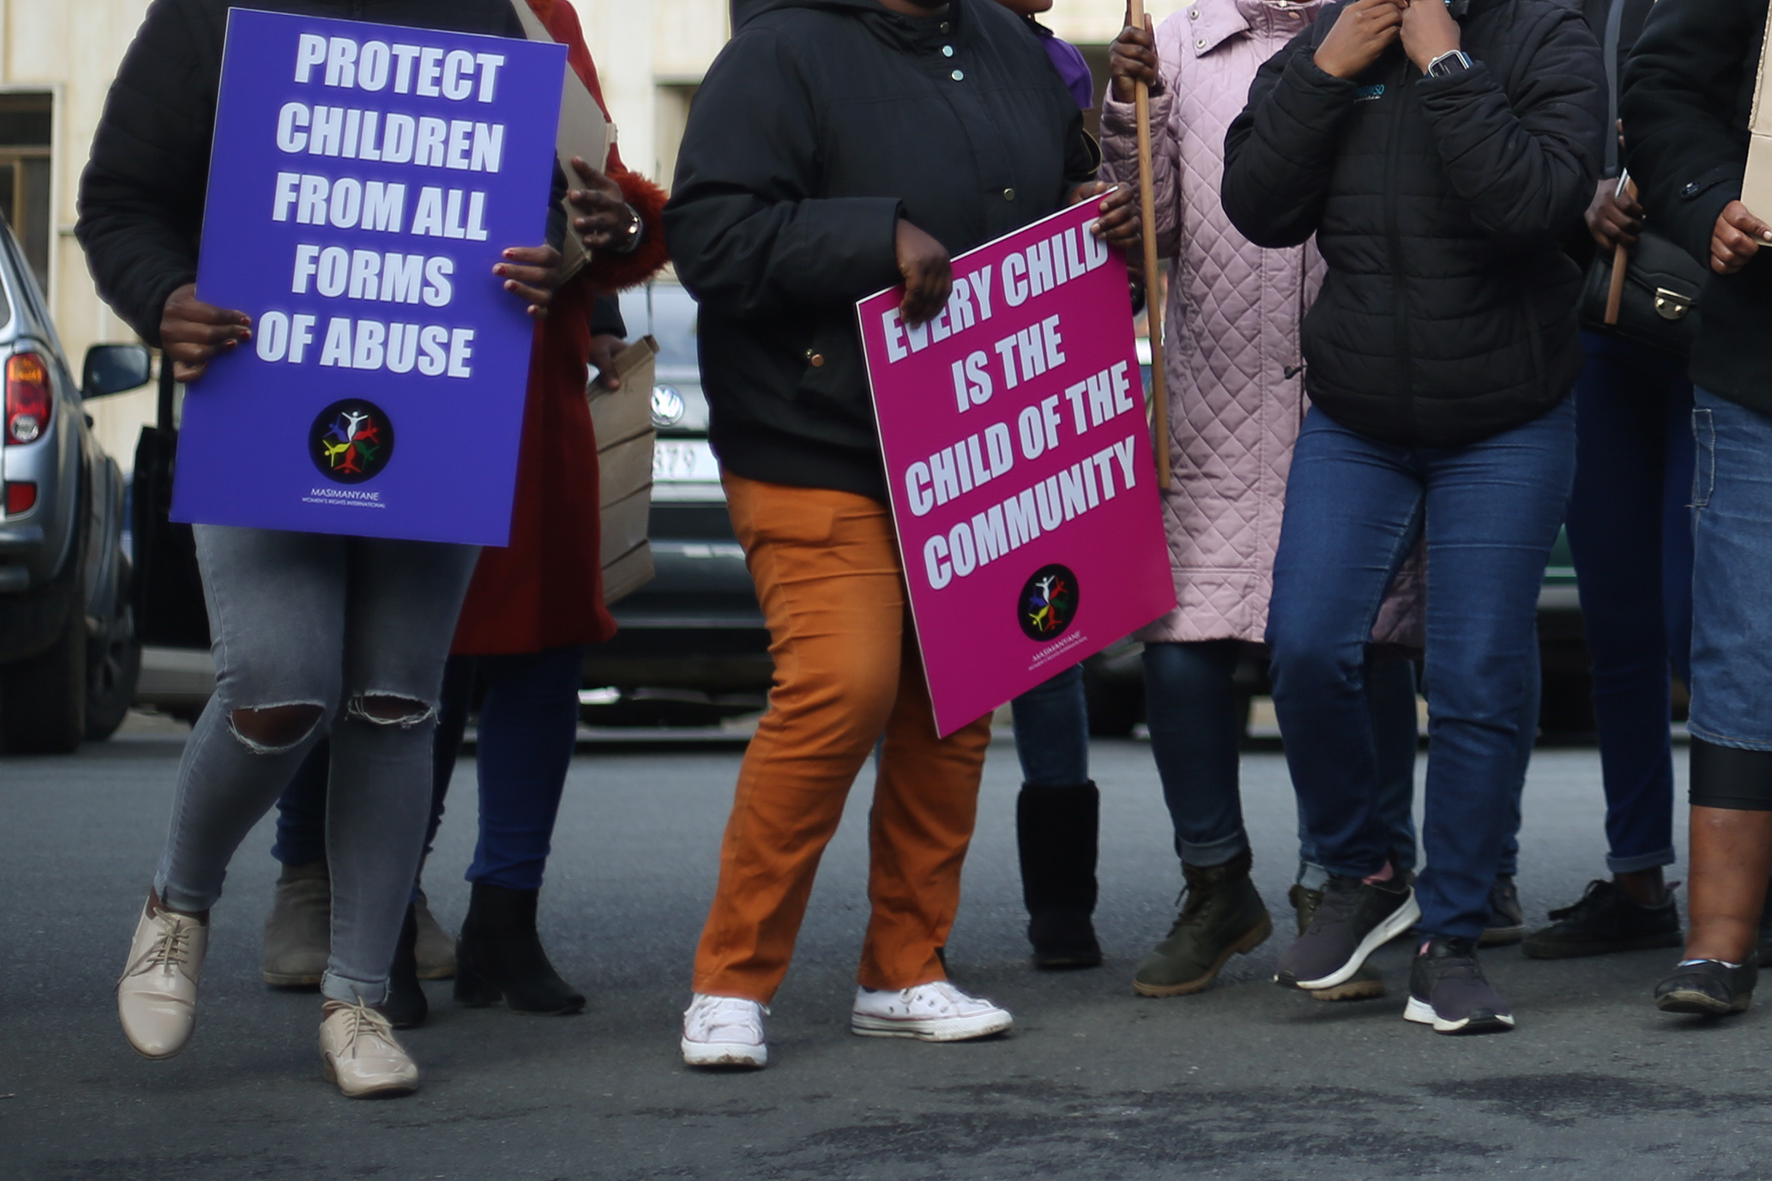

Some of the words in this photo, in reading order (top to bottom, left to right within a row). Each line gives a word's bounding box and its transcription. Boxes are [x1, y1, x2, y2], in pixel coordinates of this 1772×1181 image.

[294, 33, 504, 103] PROTECT
[276, 102, 504, 173] CHILDREN
[272, 171, 405, 233] FROM
[411, 185, 487, 241] ALL
[292, 243, 454, 307] FORMS
[1001, 217, 1109, 307] CHILD
[256, 311, 315, 364] OF
[319, 317, 475, 378] ABUSE
[951, 349, 992, 413] IS
[994, 314, 1066, 390] THE
[904, 421, 1014, 517] CHILD
[1017, 394, 1062, 460] OF
[1064, 360, 1134, 436] THE
[311, 488, 379, 501] MASIMANYANE
[923, 435, 1136, 590] COMMUNITY
